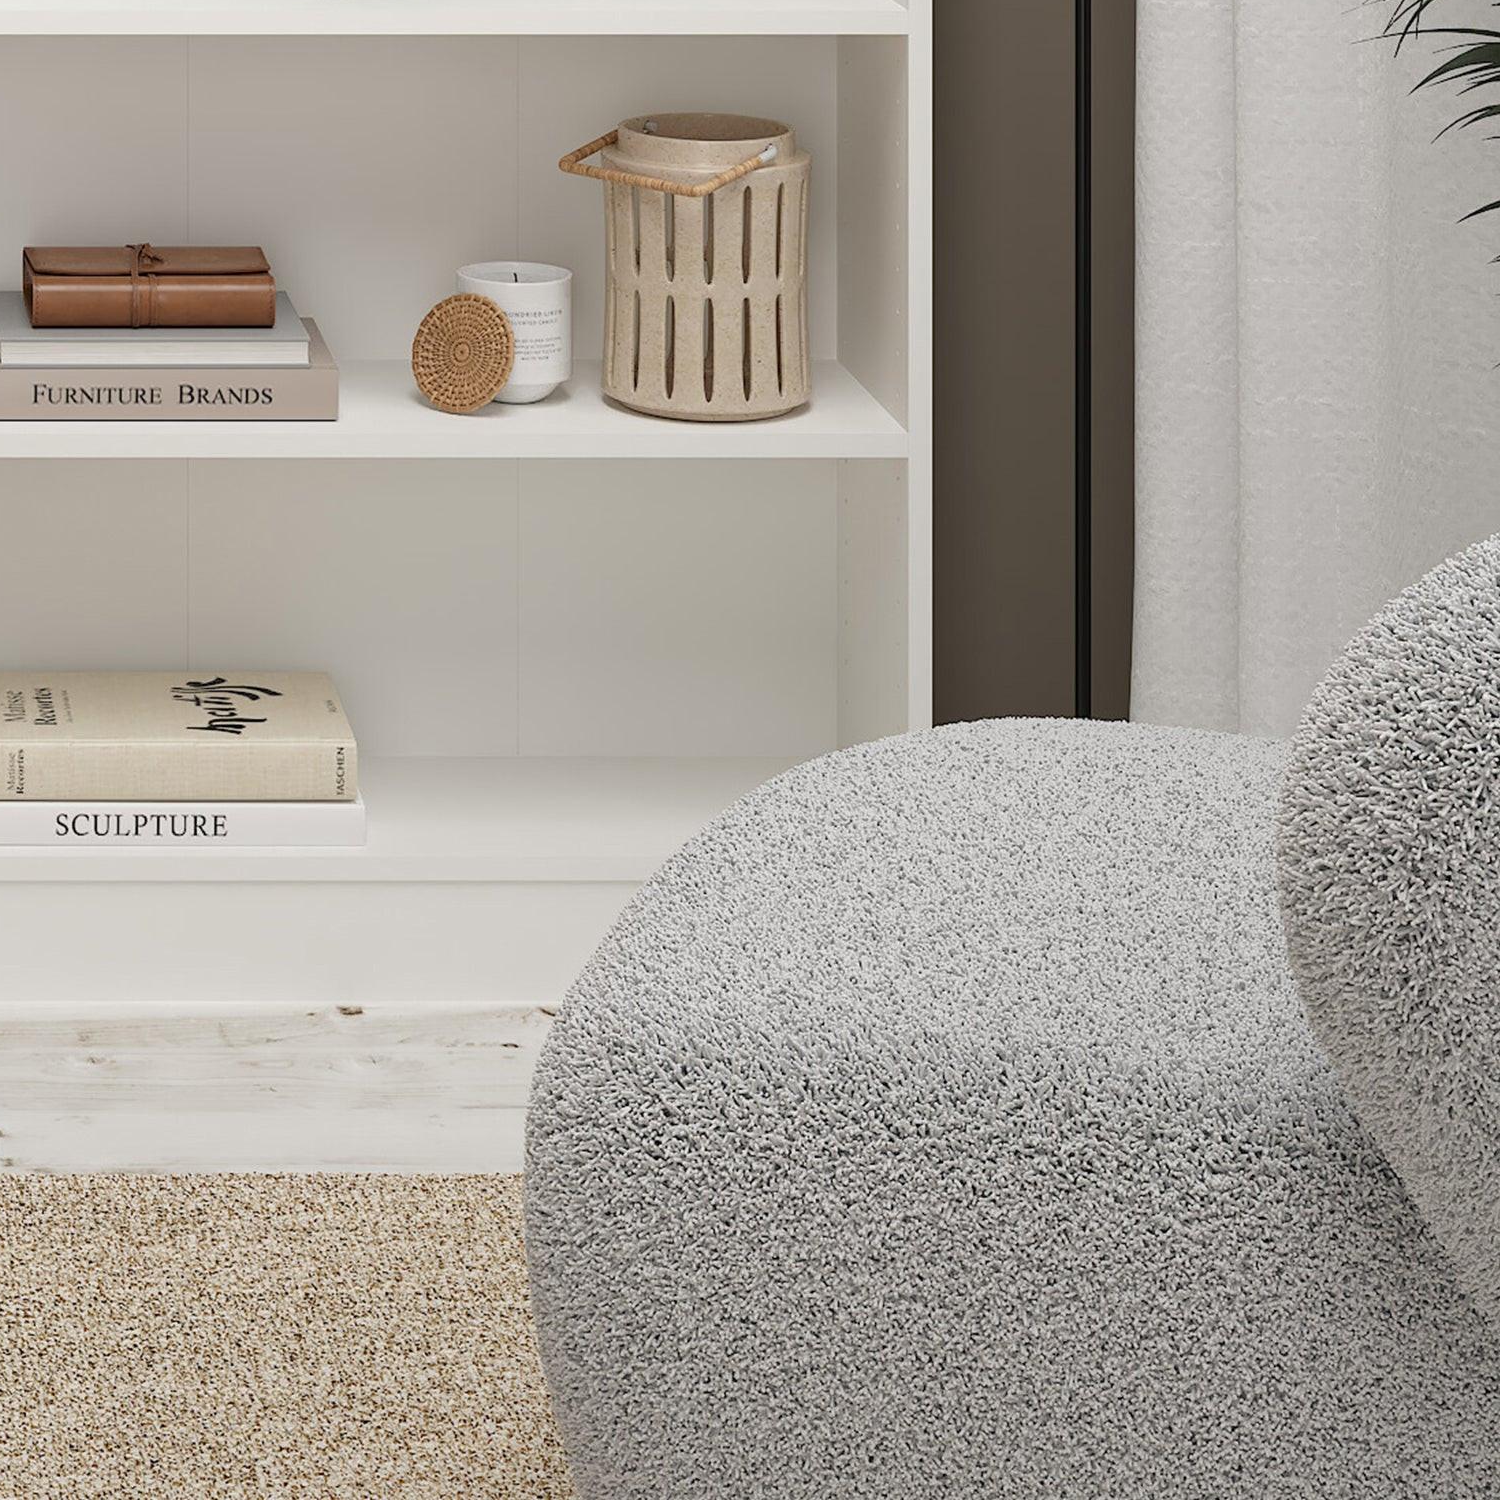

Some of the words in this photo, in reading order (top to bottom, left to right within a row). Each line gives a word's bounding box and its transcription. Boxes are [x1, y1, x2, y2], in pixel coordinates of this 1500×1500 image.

[32, 383, 163, 405] FURNITURE
[178, 383, 274, 405] BRANDS
[1, 689, 27, 722] Matisse
[33, 687, 58, 725] Recortes
[6, 752, 16, 791] Matisse
[15, 749, 25, 794] Recortes
[336, 746, 346, 796] TASCHEN
[55, 812, 228, 837] SCULPTURE
